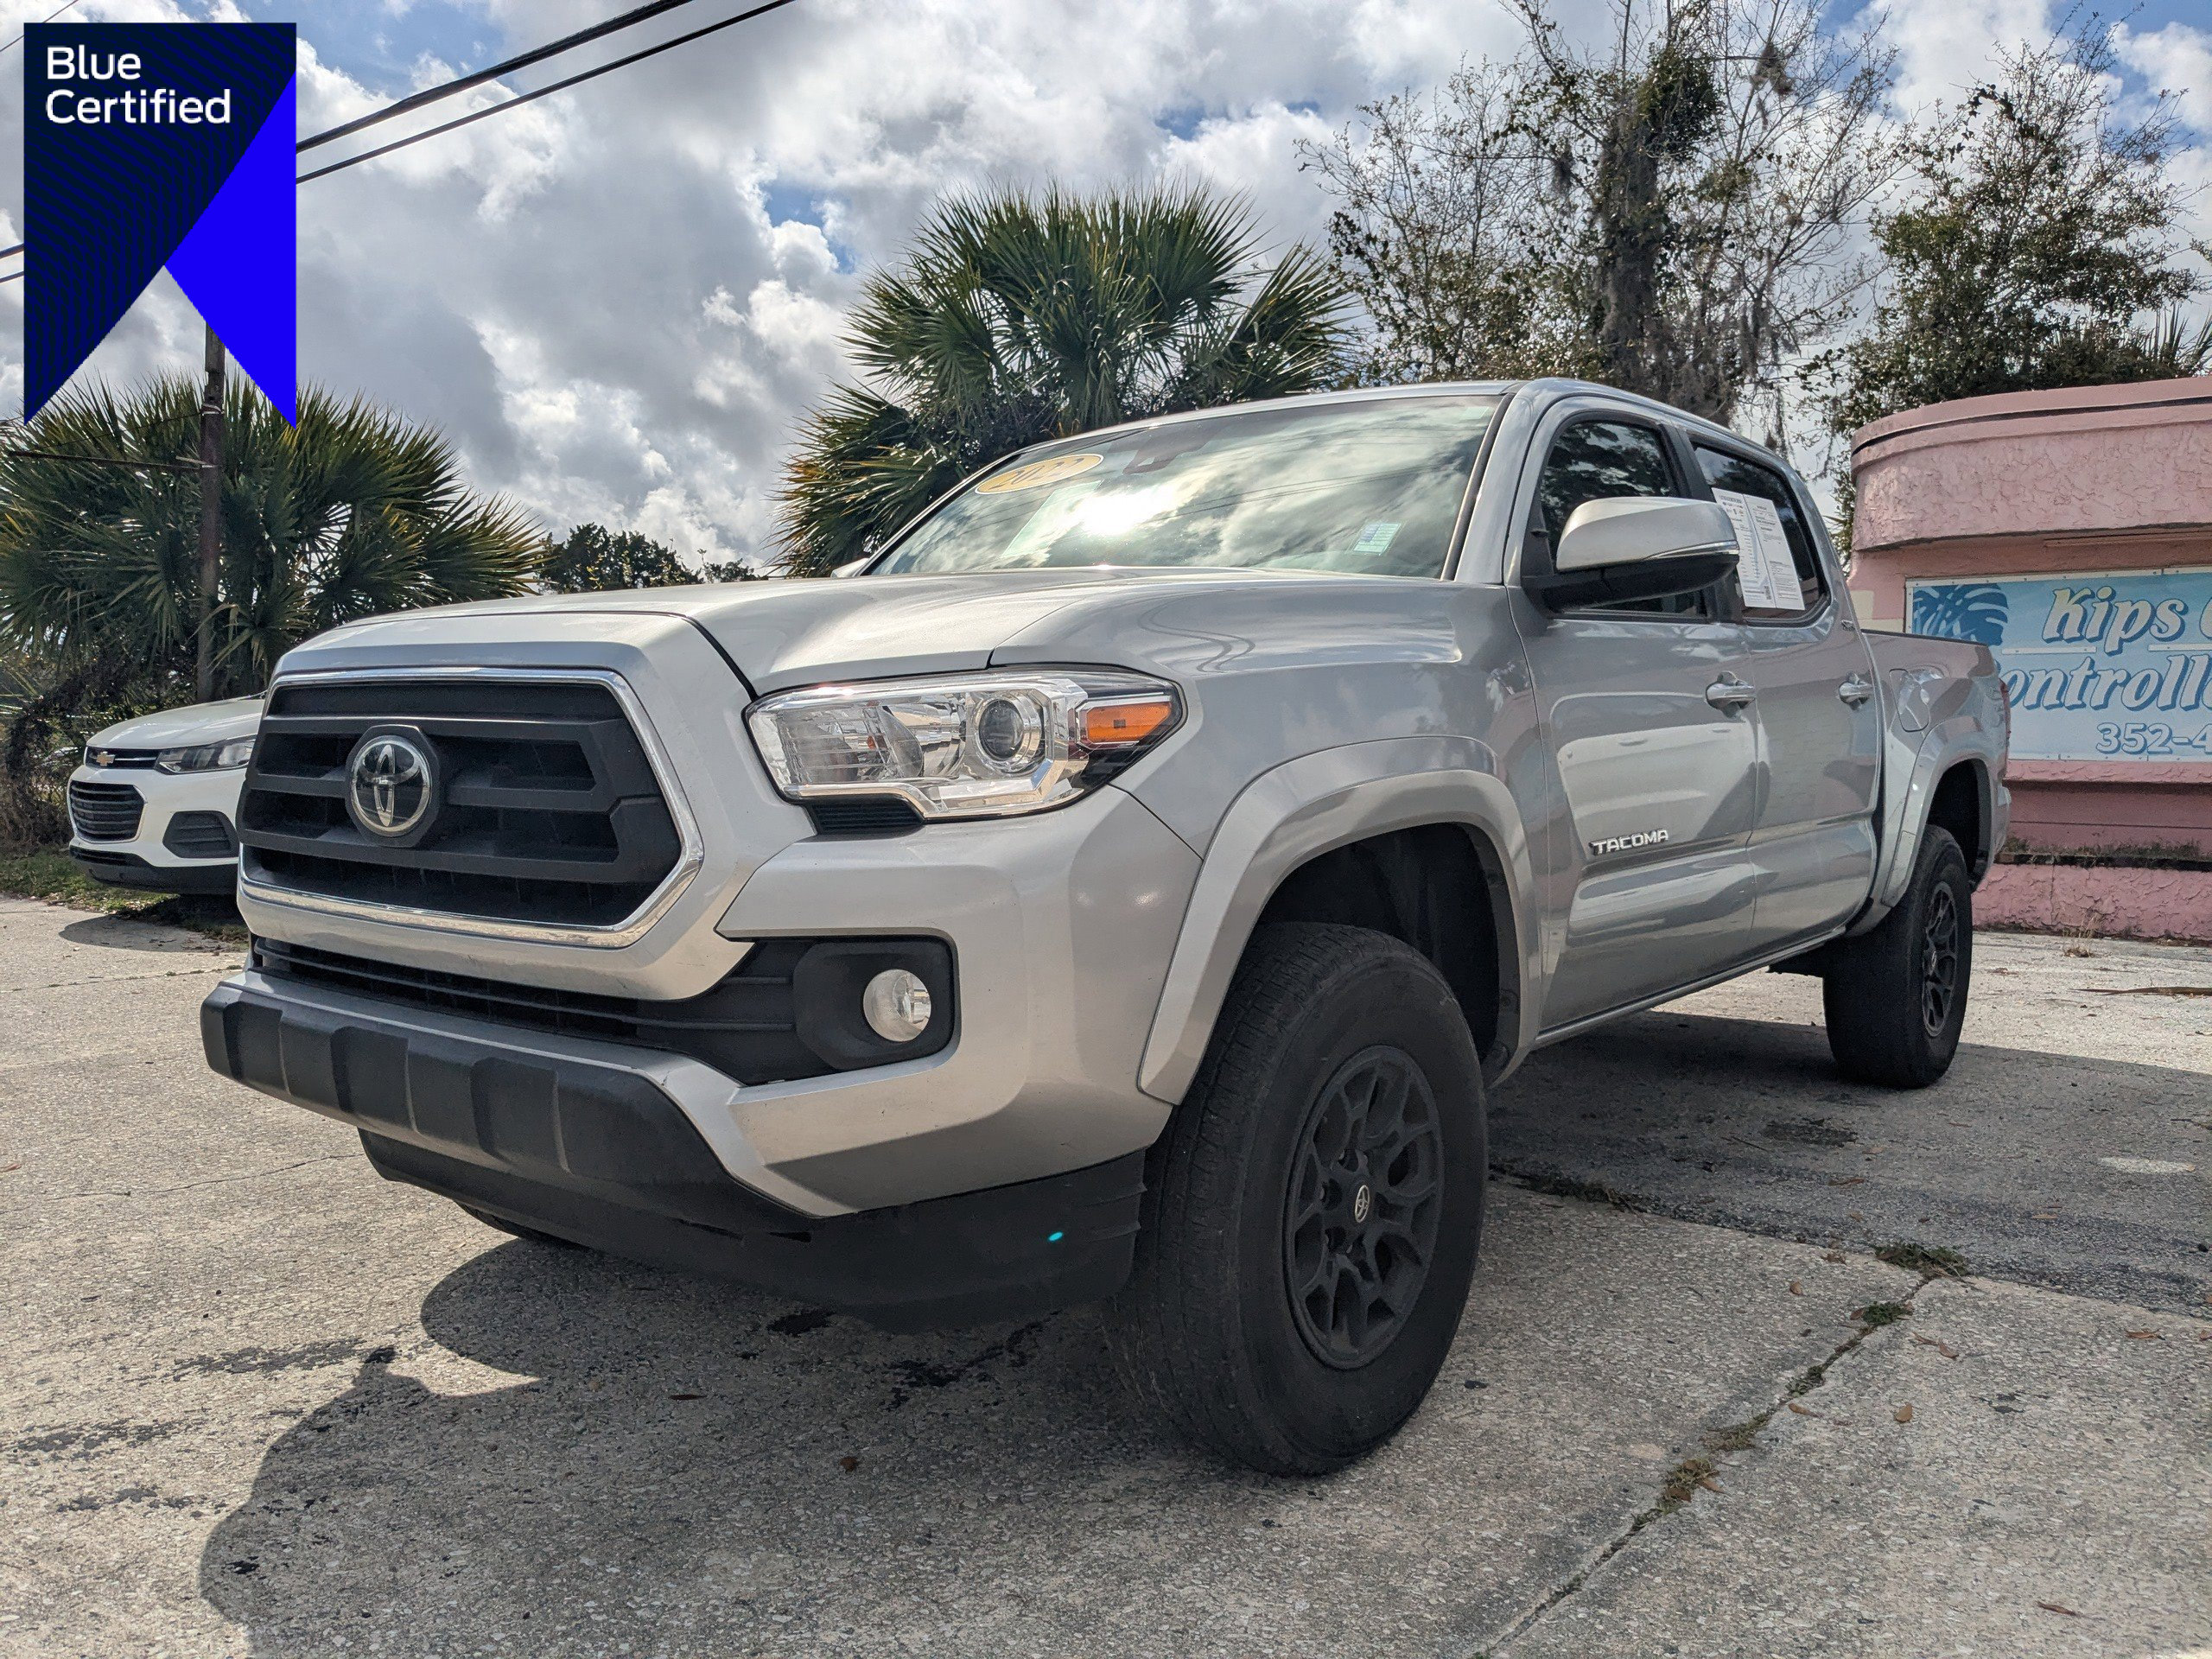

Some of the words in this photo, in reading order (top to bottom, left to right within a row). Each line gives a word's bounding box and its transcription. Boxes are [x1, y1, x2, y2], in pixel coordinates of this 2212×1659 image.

[2041, 585, 2189, 656] Kips
[1994, 653, 2212, 712] ontroll
[1589, 828, 1669, 856] TACOMA
